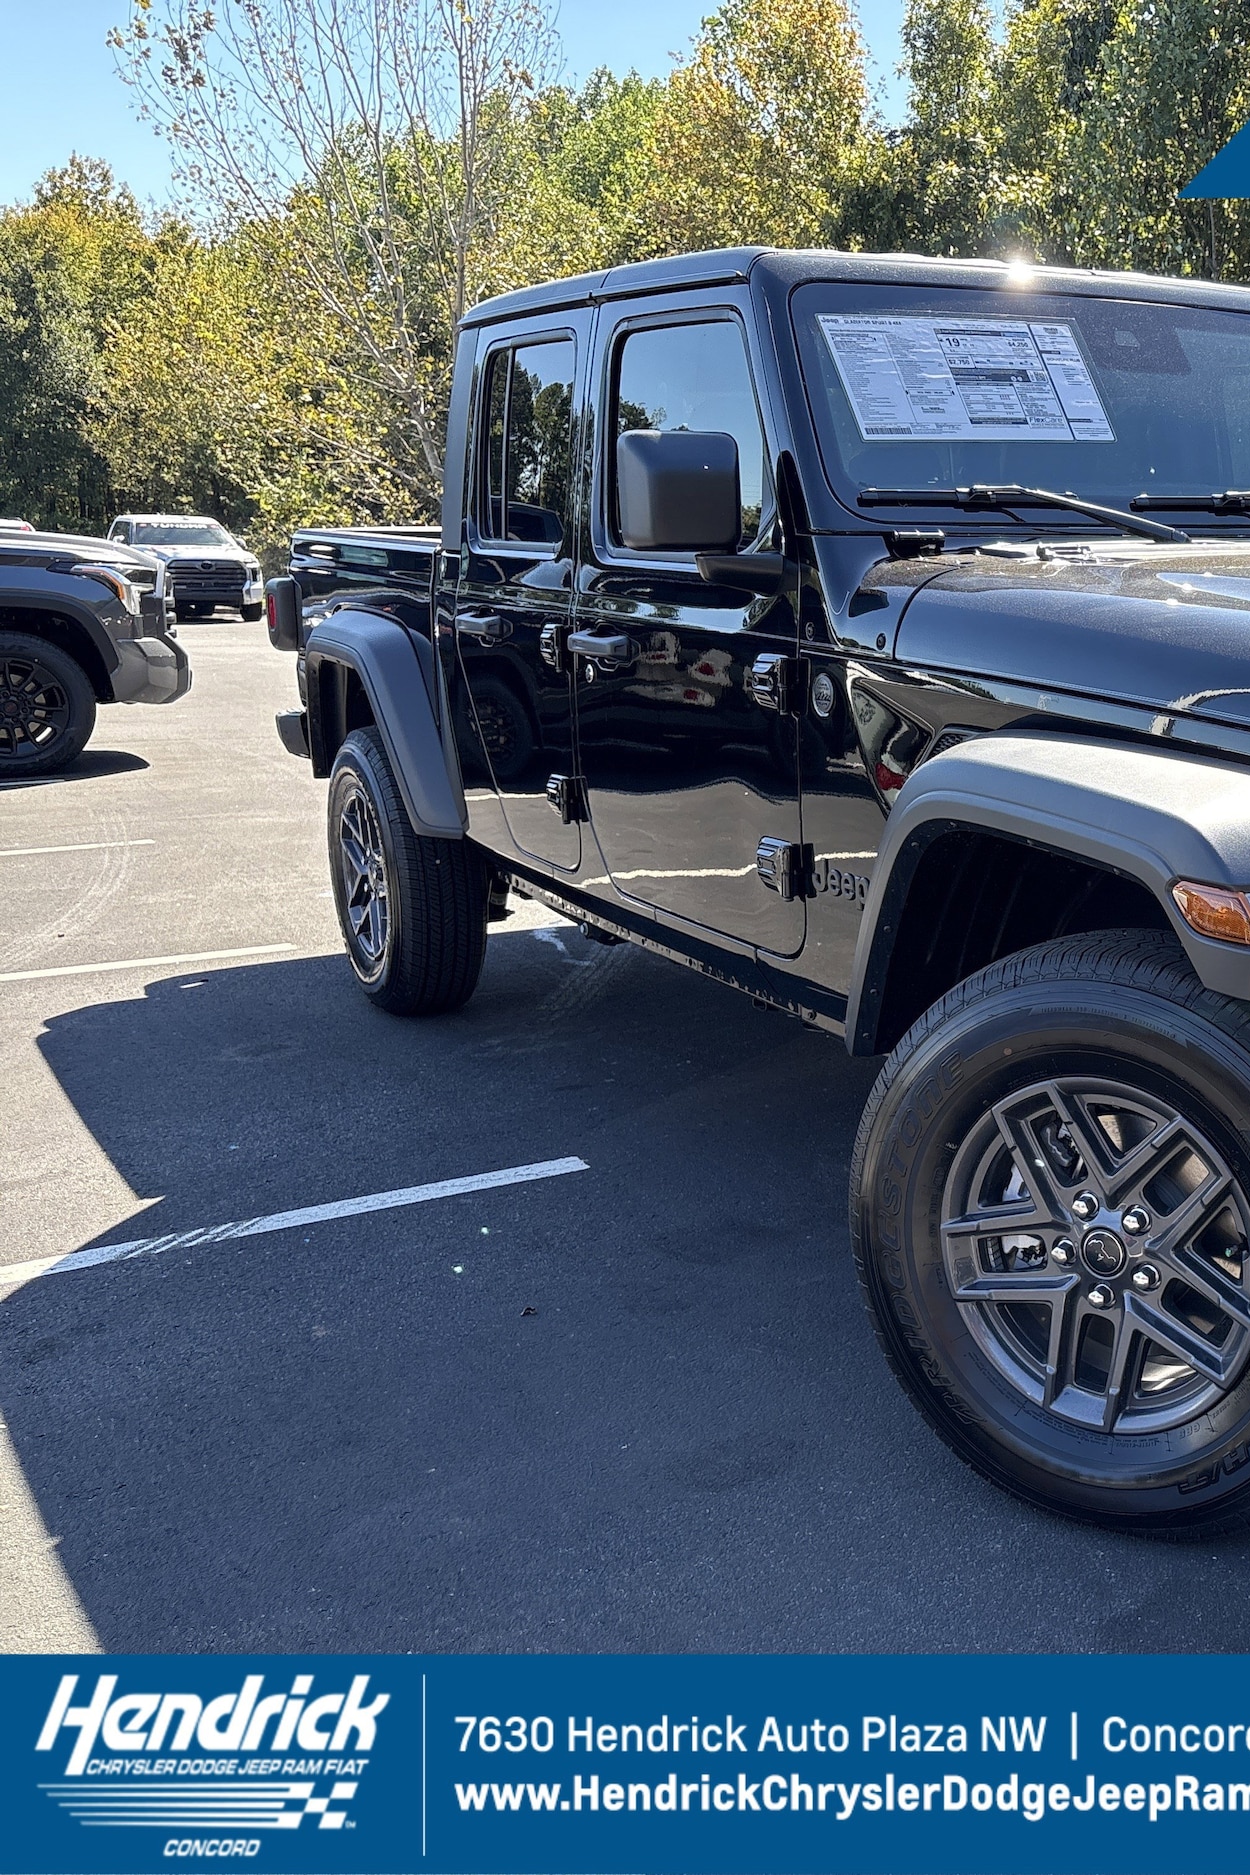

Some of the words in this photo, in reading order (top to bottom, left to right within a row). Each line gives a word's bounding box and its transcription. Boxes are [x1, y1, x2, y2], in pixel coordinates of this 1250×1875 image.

[945, 337, 960, 347] 19
[812, 858, 870, 911] Jeep
[879, 1050, 980, 1426] BRIDGESTONE
